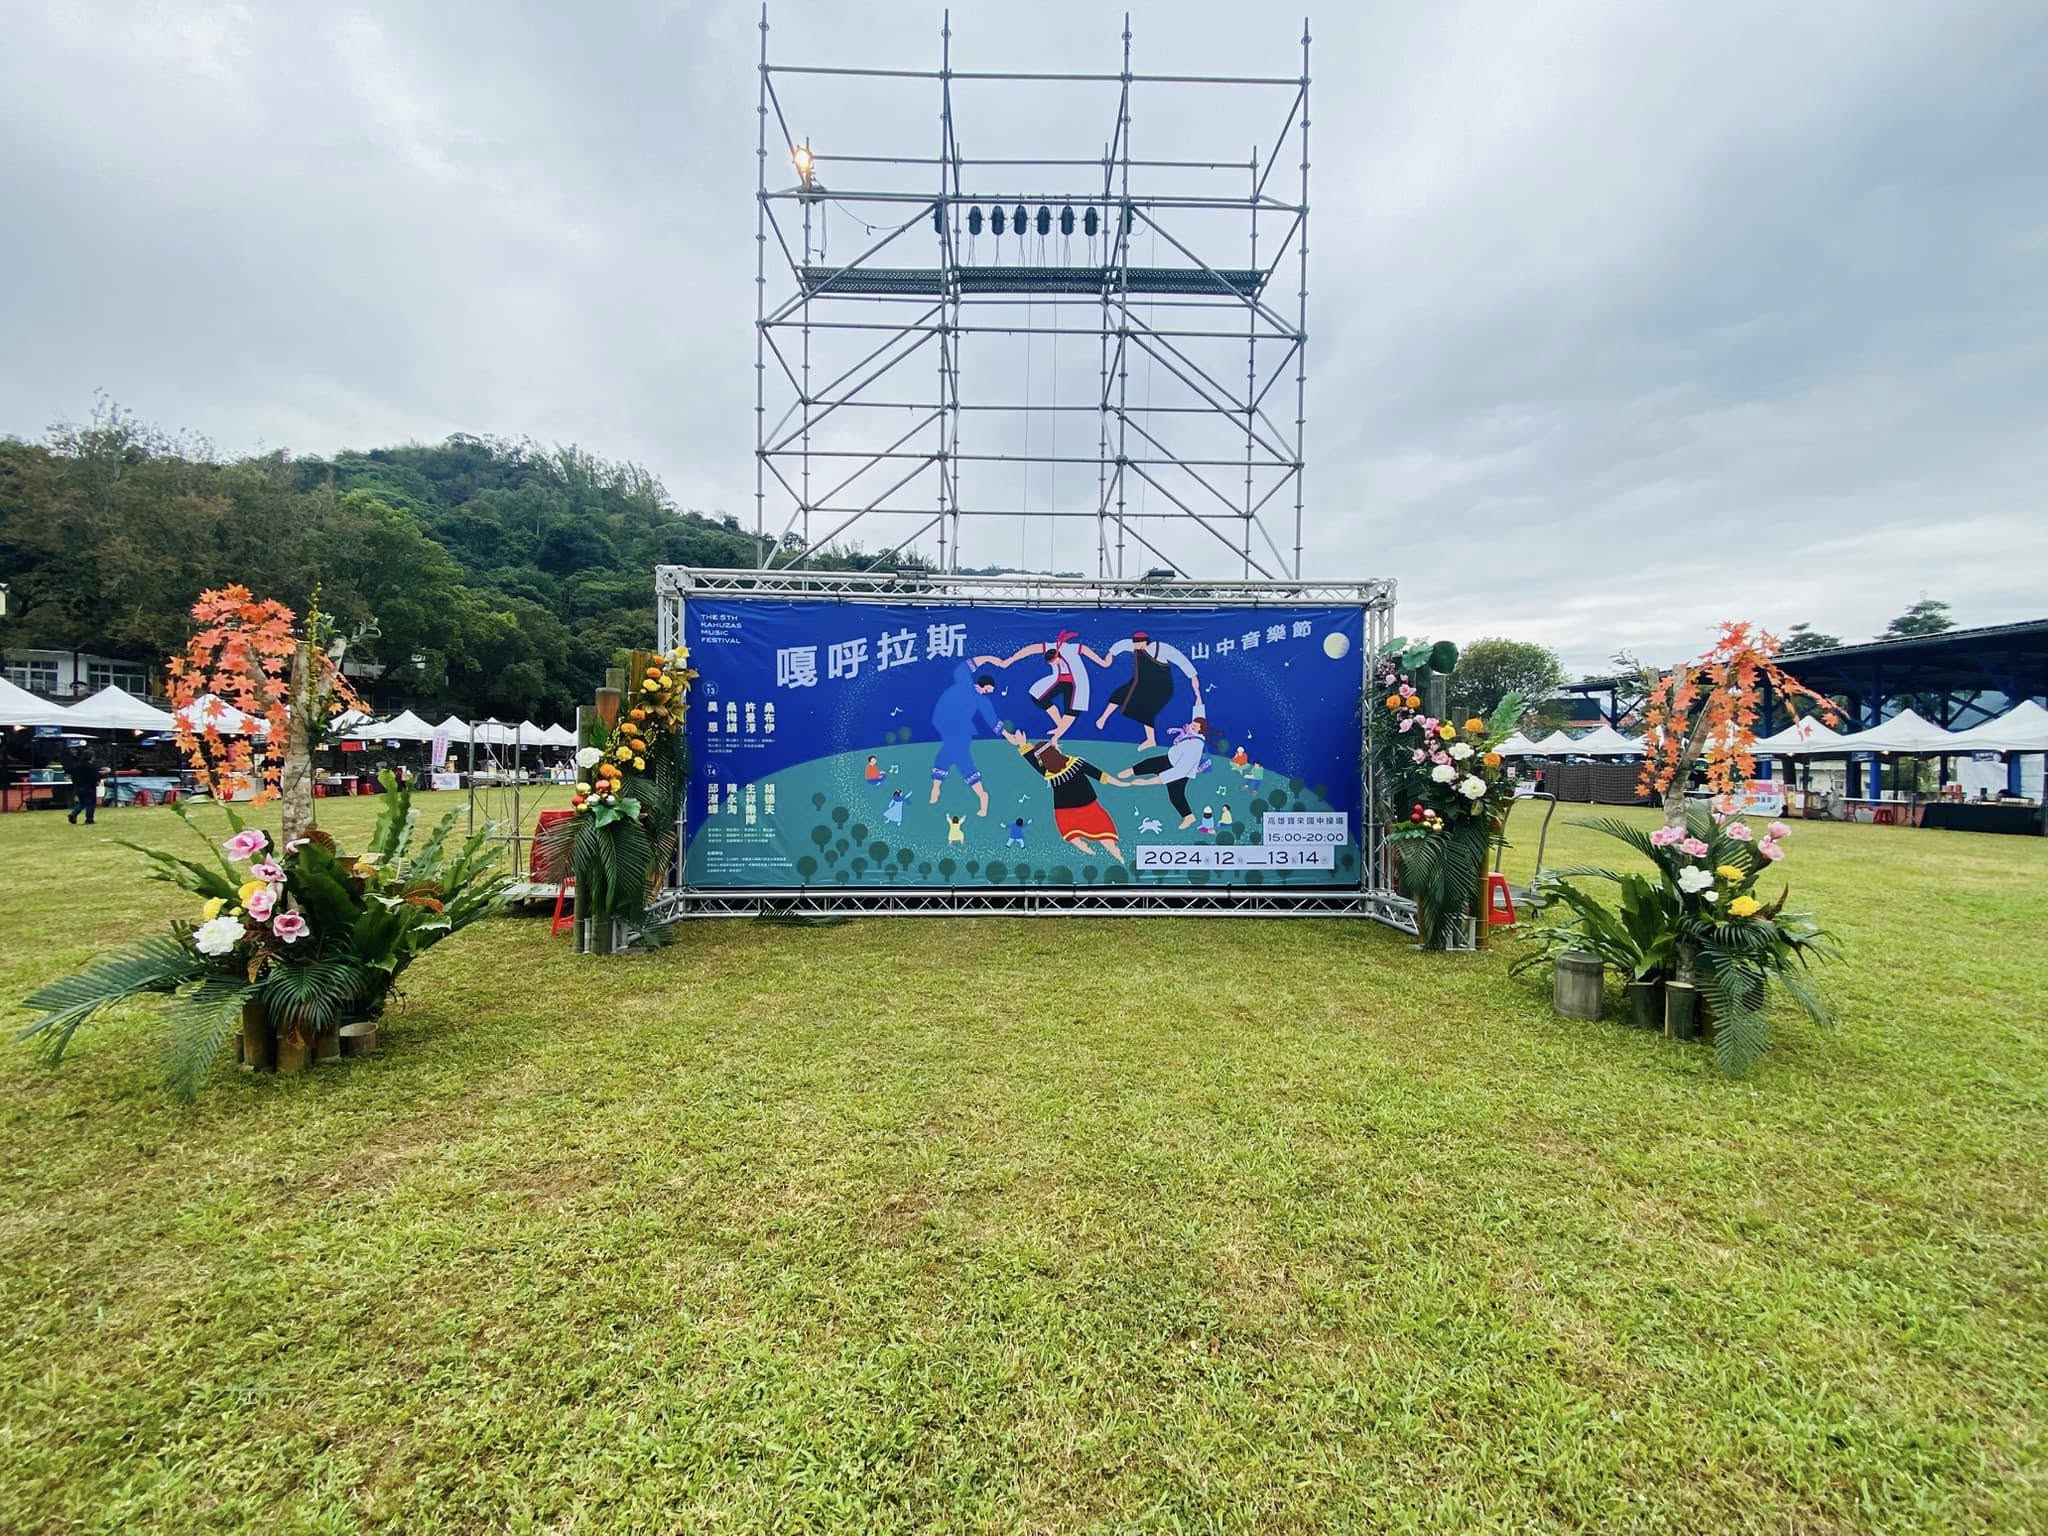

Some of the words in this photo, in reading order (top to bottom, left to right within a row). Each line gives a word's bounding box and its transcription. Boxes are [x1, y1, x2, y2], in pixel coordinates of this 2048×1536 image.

[1191, 620, 1312, 660] 山中音樂節
[1268, 833, 1344, 842] 15:00-20:00
